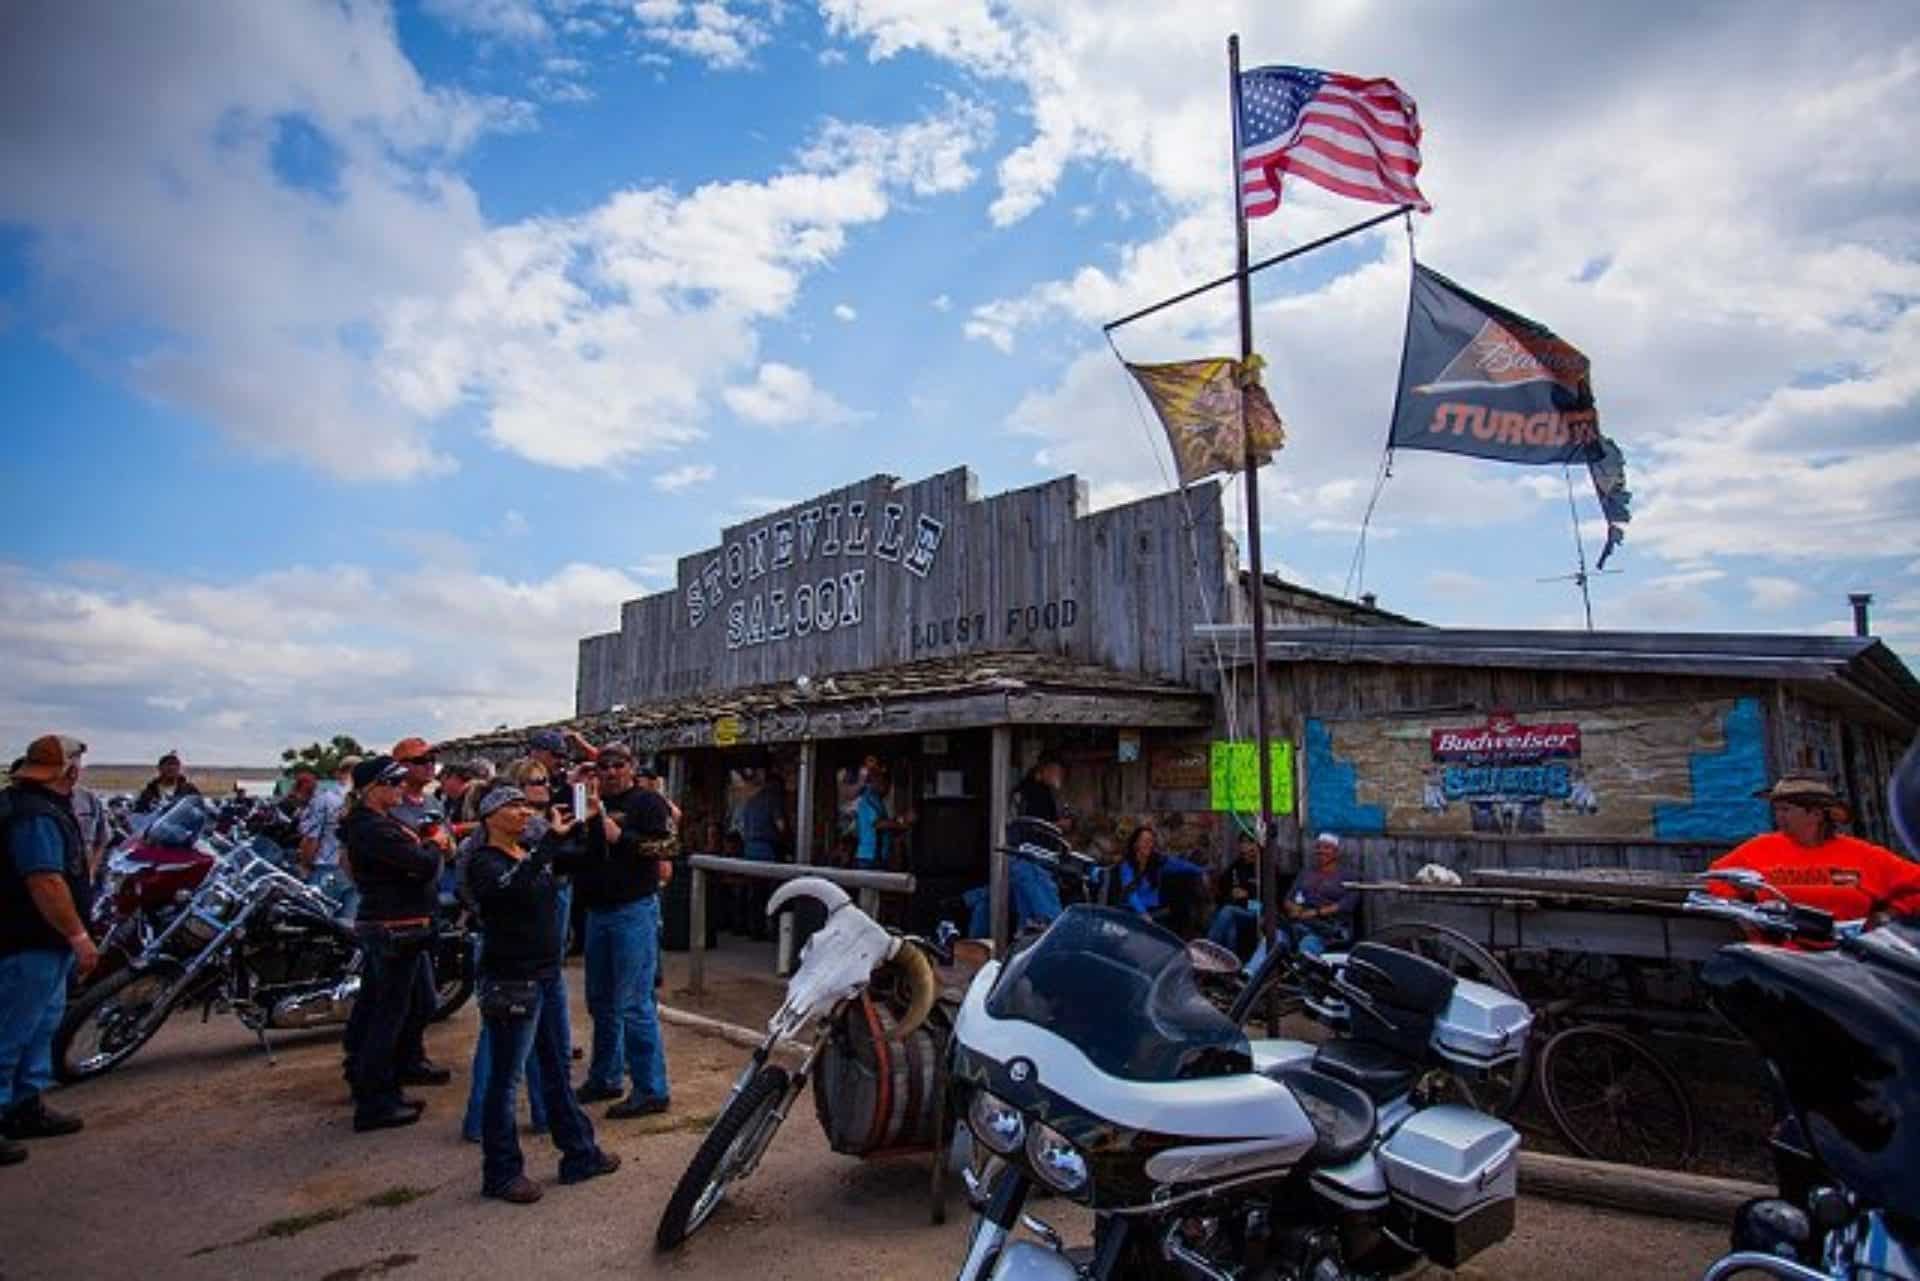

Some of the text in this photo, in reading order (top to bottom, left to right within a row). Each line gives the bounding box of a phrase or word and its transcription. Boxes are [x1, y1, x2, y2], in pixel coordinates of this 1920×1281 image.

[686, 499, 945, 629] STONEVILLE
[726, 568, 866, 651] SALOON
[1007, 599, 1078, 635] FOOD
[1435, 731, 1578, 752] Budweiser
